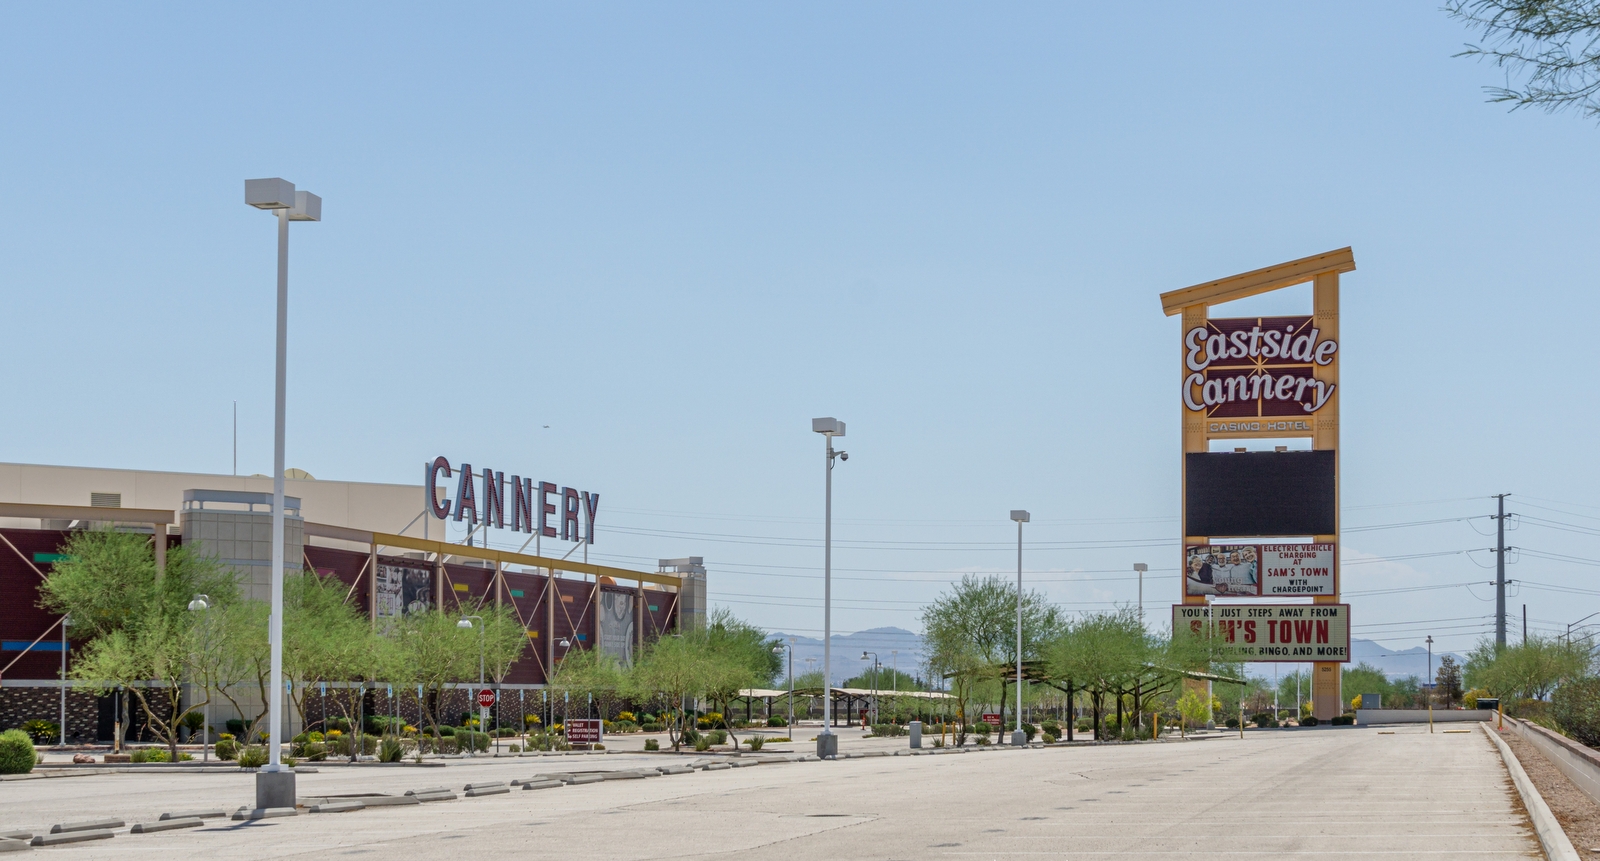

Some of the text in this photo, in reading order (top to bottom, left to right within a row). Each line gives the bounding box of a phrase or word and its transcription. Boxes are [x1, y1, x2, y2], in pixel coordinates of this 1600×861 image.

[1185, 325, 1339, 372] Eastside
[1182, 372, 1337, 413] Cannery
[1210, 421, 1310, 432] CASINO HOTEL
[427, 455, 600, 545] CANNERY
[1263, 544, 1332, 552] ELECTRIC VEHICLE
[1267, 568, 1329, 577] SAM'S TOWN
[1220, 608, 1242, 617] JUST
[1248, 608, 1273, 617] STEPS
[1279, 608, 1304, 617] AWAY
[1311, 608, 1338, 617] FROM
[1267, 620, 1329, 644] TOWN
[1293, 646, 1313, 656] AND
[1317, 646, 1347, 656] MORE!
[479, 694, 494, 702] STOP
